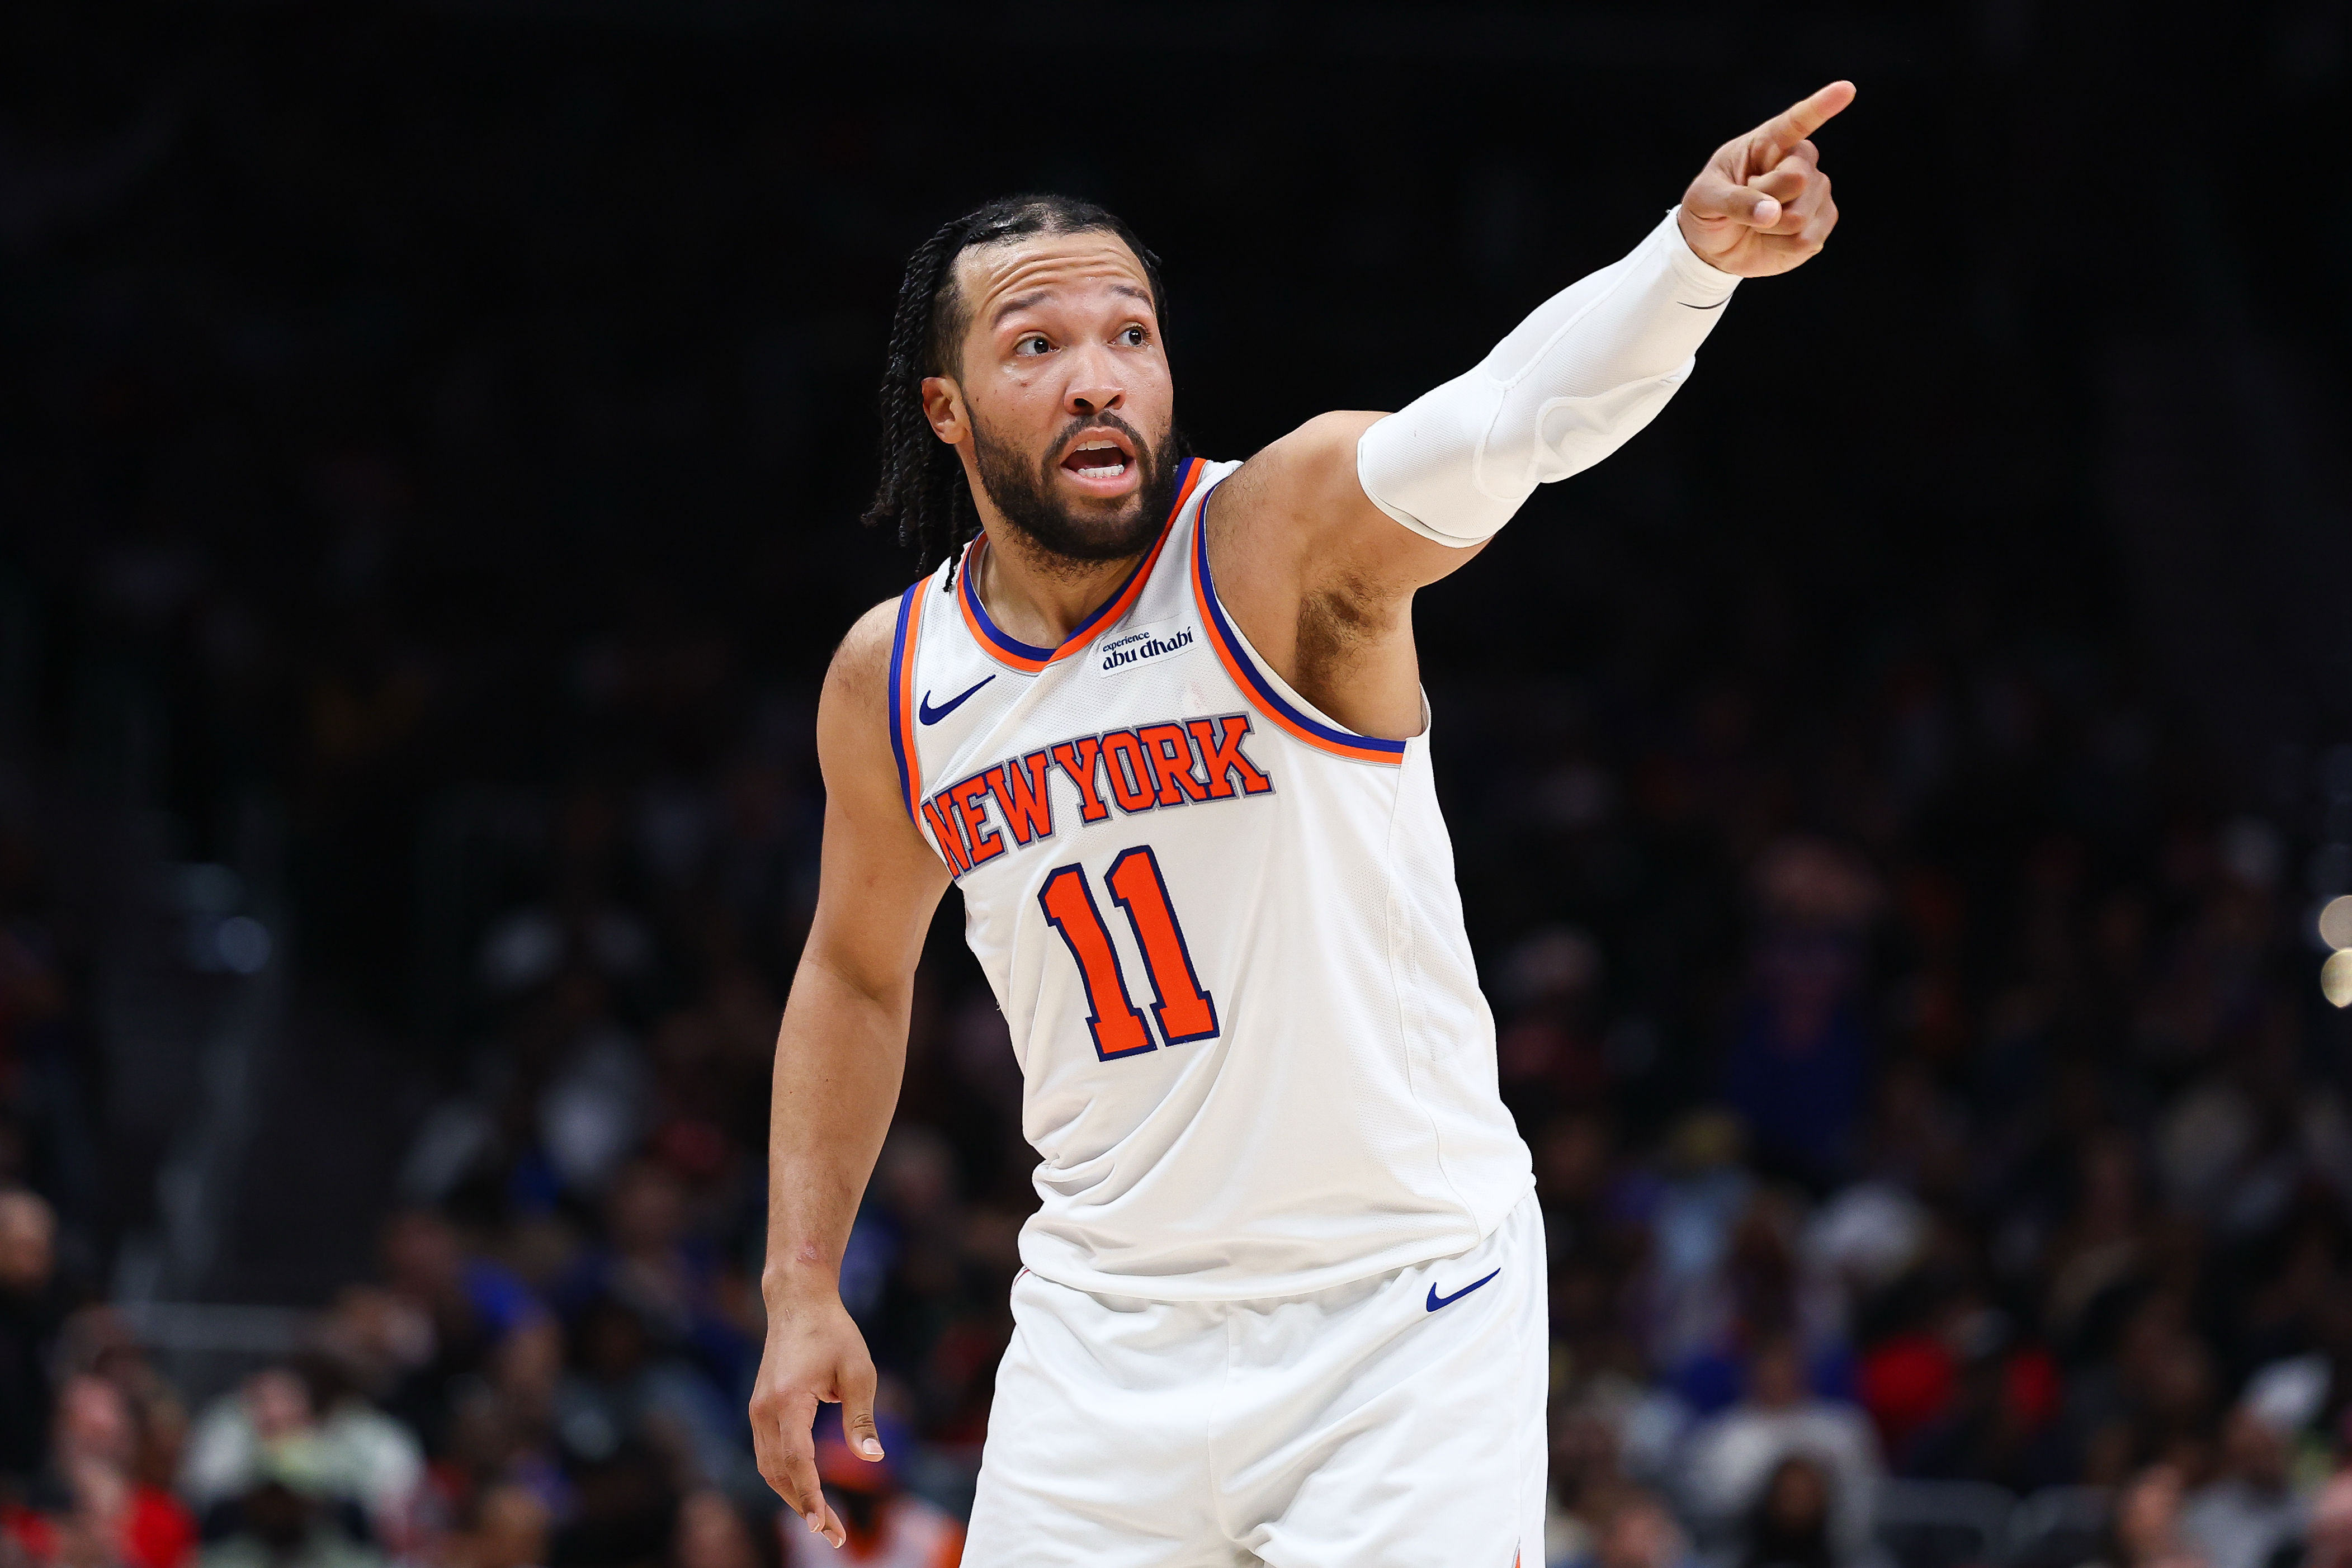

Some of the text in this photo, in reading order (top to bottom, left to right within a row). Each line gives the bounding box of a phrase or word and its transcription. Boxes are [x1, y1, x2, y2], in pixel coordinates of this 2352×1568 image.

[1103, 632, 1150, 652] experience
[1103, 626, 1193, 670] abu dhabi
[920, 712, 1276, 881] NEW YORK
[1037, 844, 1220, 1061] 11
